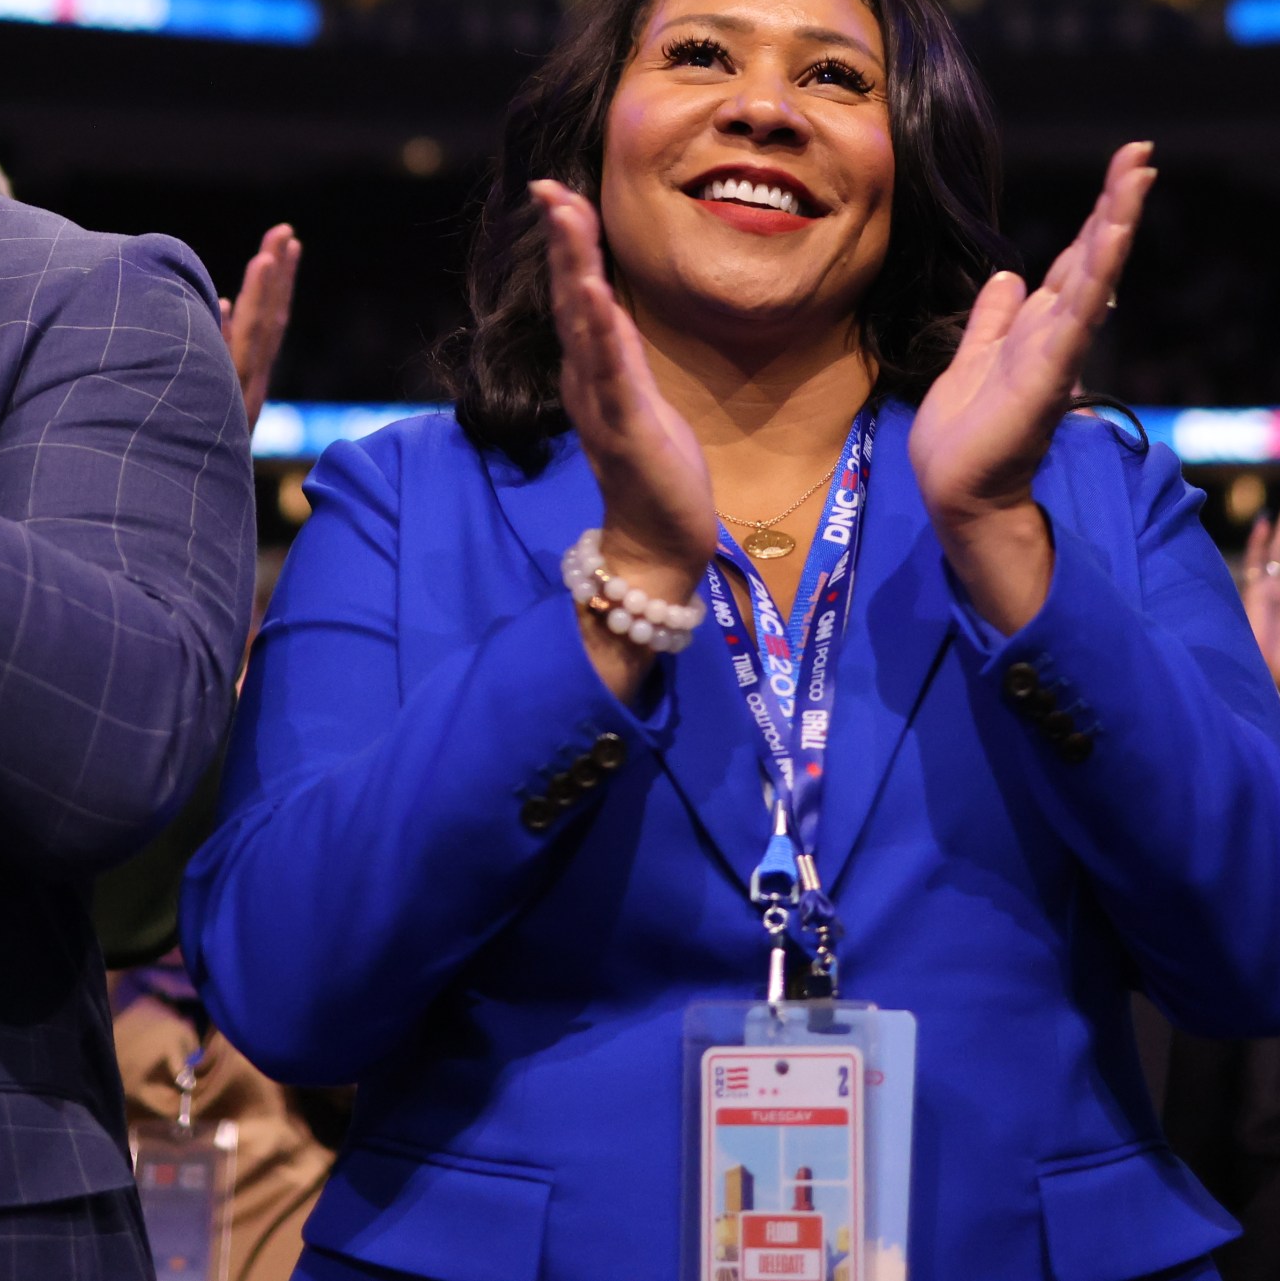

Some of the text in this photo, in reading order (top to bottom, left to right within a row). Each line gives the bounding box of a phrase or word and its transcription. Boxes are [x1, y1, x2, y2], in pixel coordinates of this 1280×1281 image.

[822, 489, 858, 545] DNC
[712, 600, 735, 627] CNN
[748, 573, 784, 637] DNC
[815, 610, 836, 642] CNN
[809, 647, 828, 701] POLITICO
[747, 692, 784, 755] POLITICO
[838, 1066, 848, 1097] 2
[752, 1109, 813, 1123] TUESDAY
